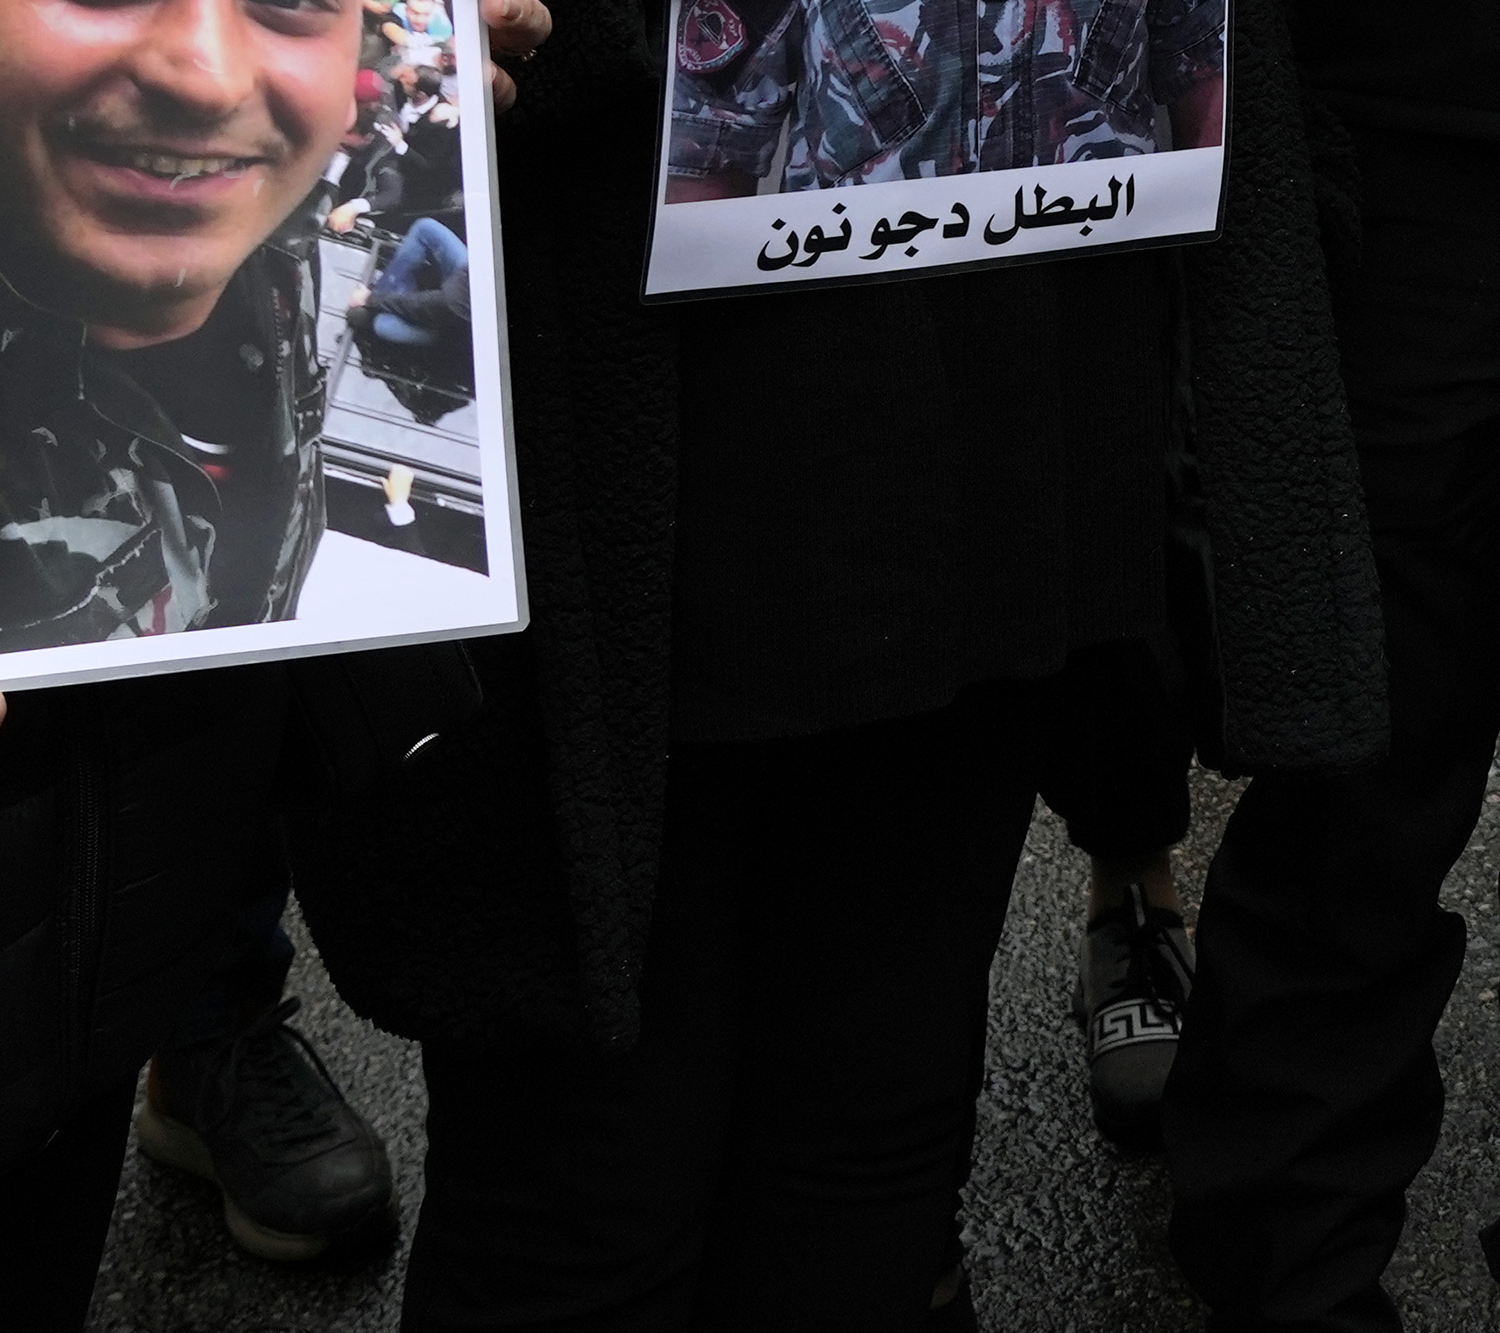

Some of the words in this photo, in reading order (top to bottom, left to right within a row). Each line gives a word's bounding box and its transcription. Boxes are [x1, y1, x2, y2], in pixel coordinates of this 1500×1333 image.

[756, 202, 853, 271] نون
[858, 202, 971, 260] دجو
[983, 173, 1135, 245] البطل
